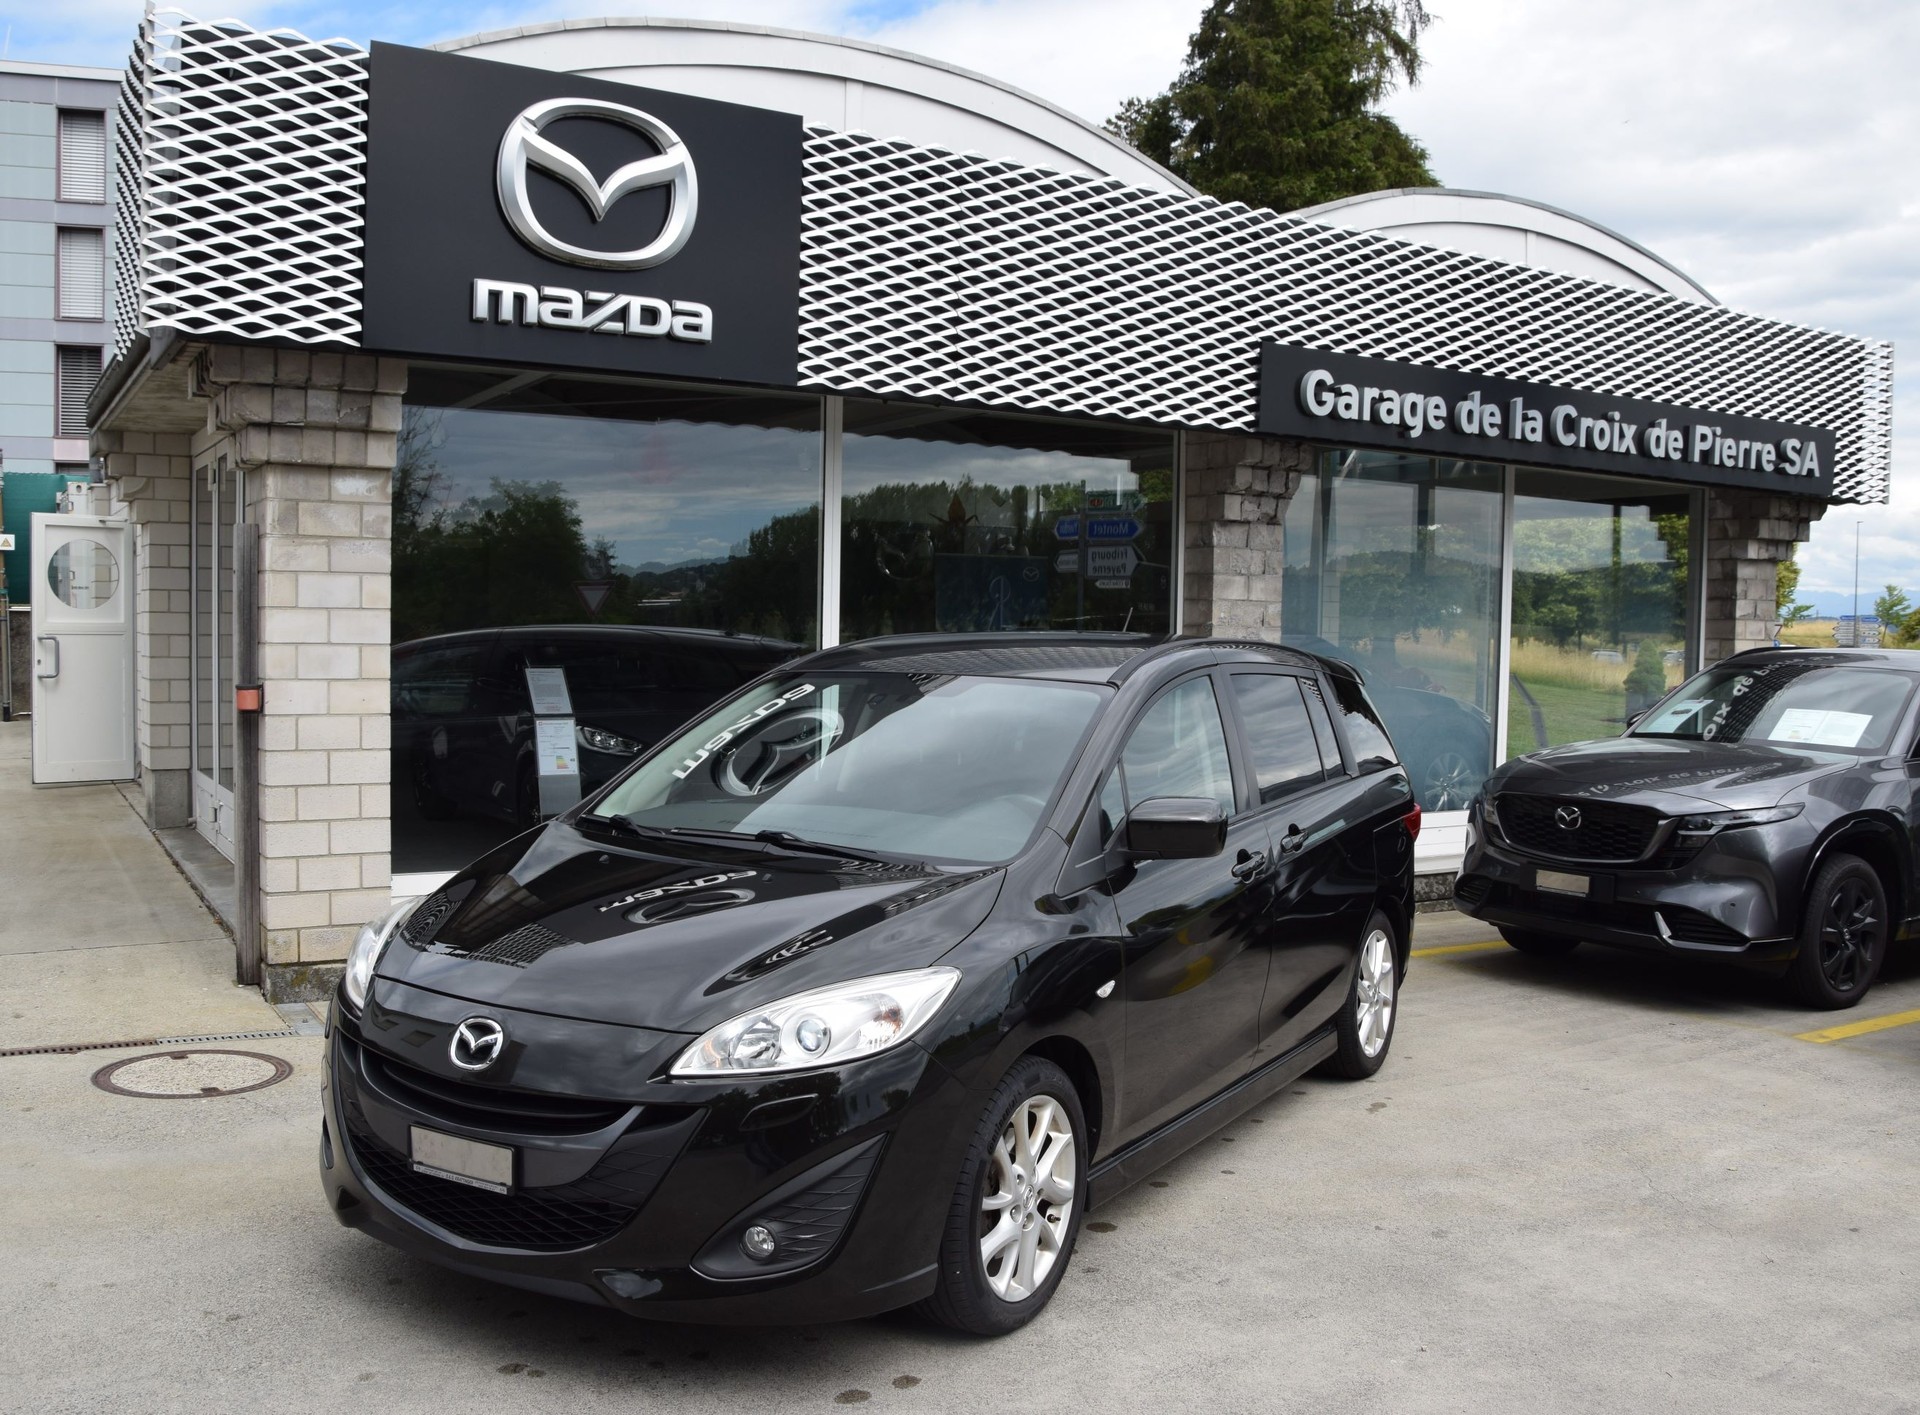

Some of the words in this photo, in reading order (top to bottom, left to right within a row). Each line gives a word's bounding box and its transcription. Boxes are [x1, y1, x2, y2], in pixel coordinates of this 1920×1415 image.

[1301, 369, 1446, 438] Garage
[1454, 390, 1502, 437] de
[1508, 396, 1543, 442] la
[1551, 404, 1637, 455] Croix
[1644, 418, 1683, 460] de
[1688, 424, 1776, 472] Pierre
[1779, 438, 1820, 477] SA
